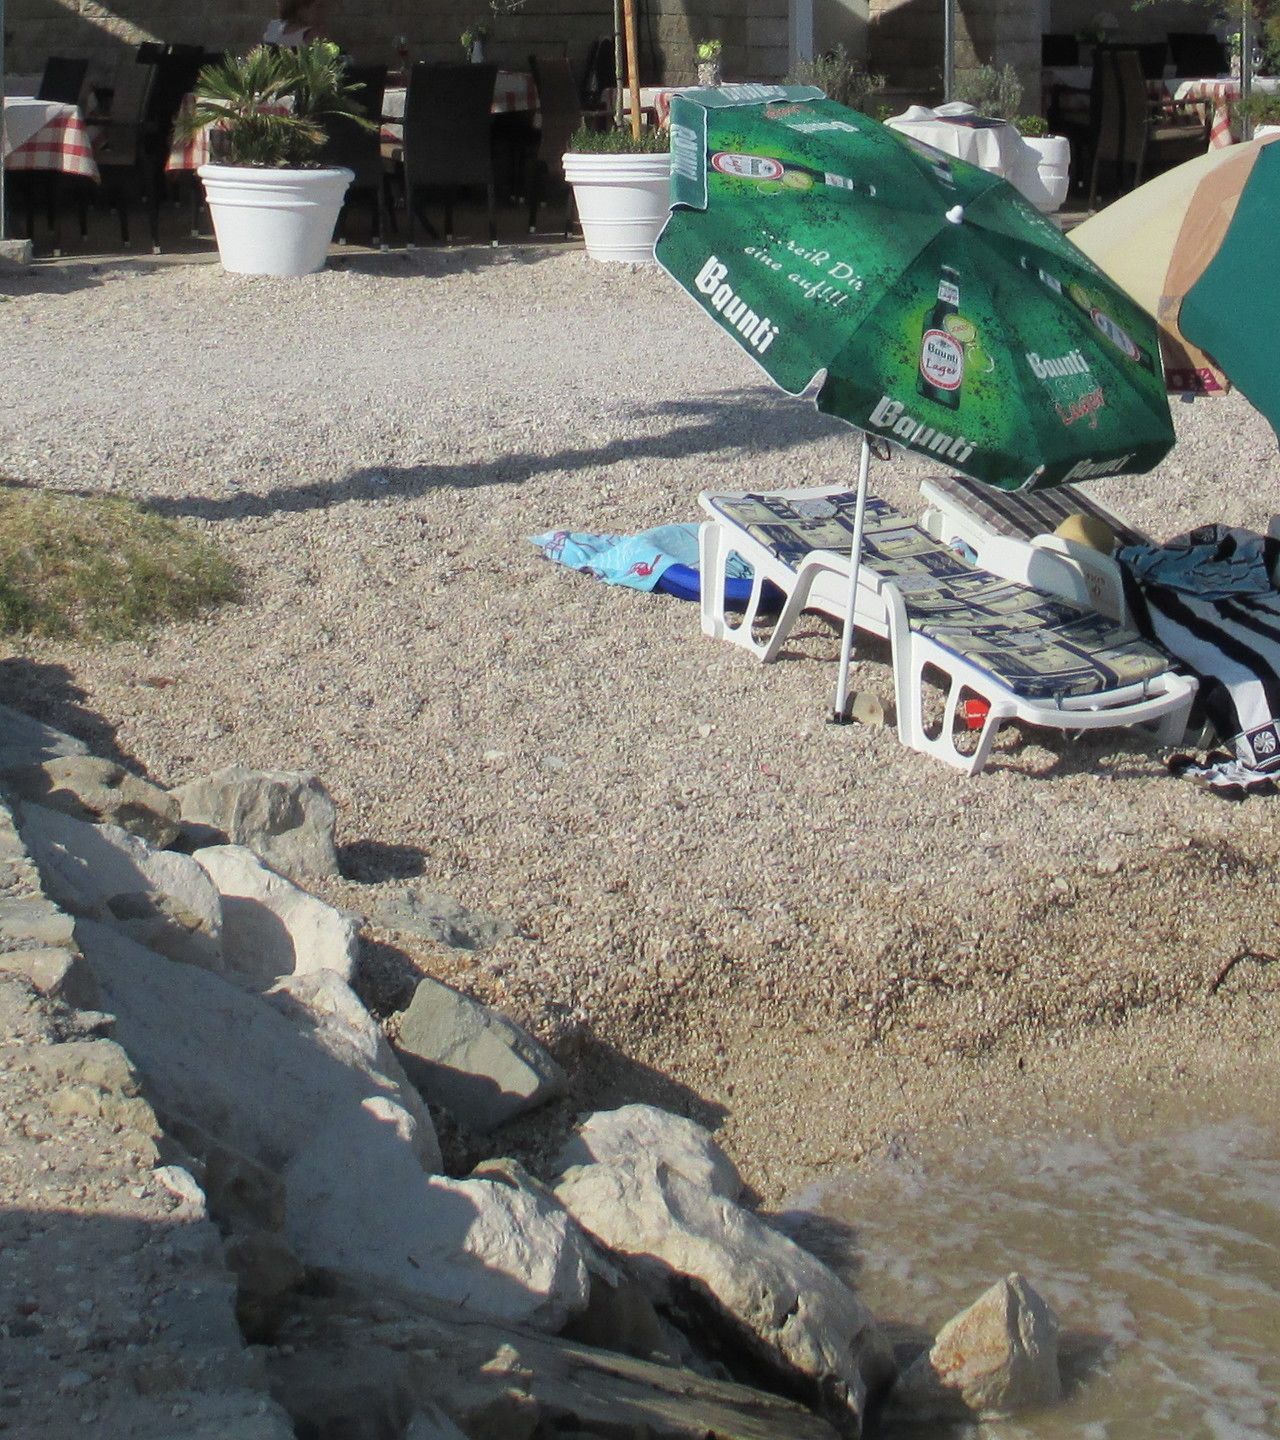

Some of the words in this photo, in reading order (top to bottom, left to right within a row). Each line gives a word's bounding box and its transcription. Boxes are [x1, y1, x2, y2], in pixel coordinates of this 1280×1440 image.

[743, 246, 783, 271] eine
[826, 261, 864, 291] Dir
[694, 255, 780, 354] Baunti
[925, 357, 958, 377] Lager
[1025, 348, 1091, 379] Baunti
[868, 395, 978, 463] Baunti
